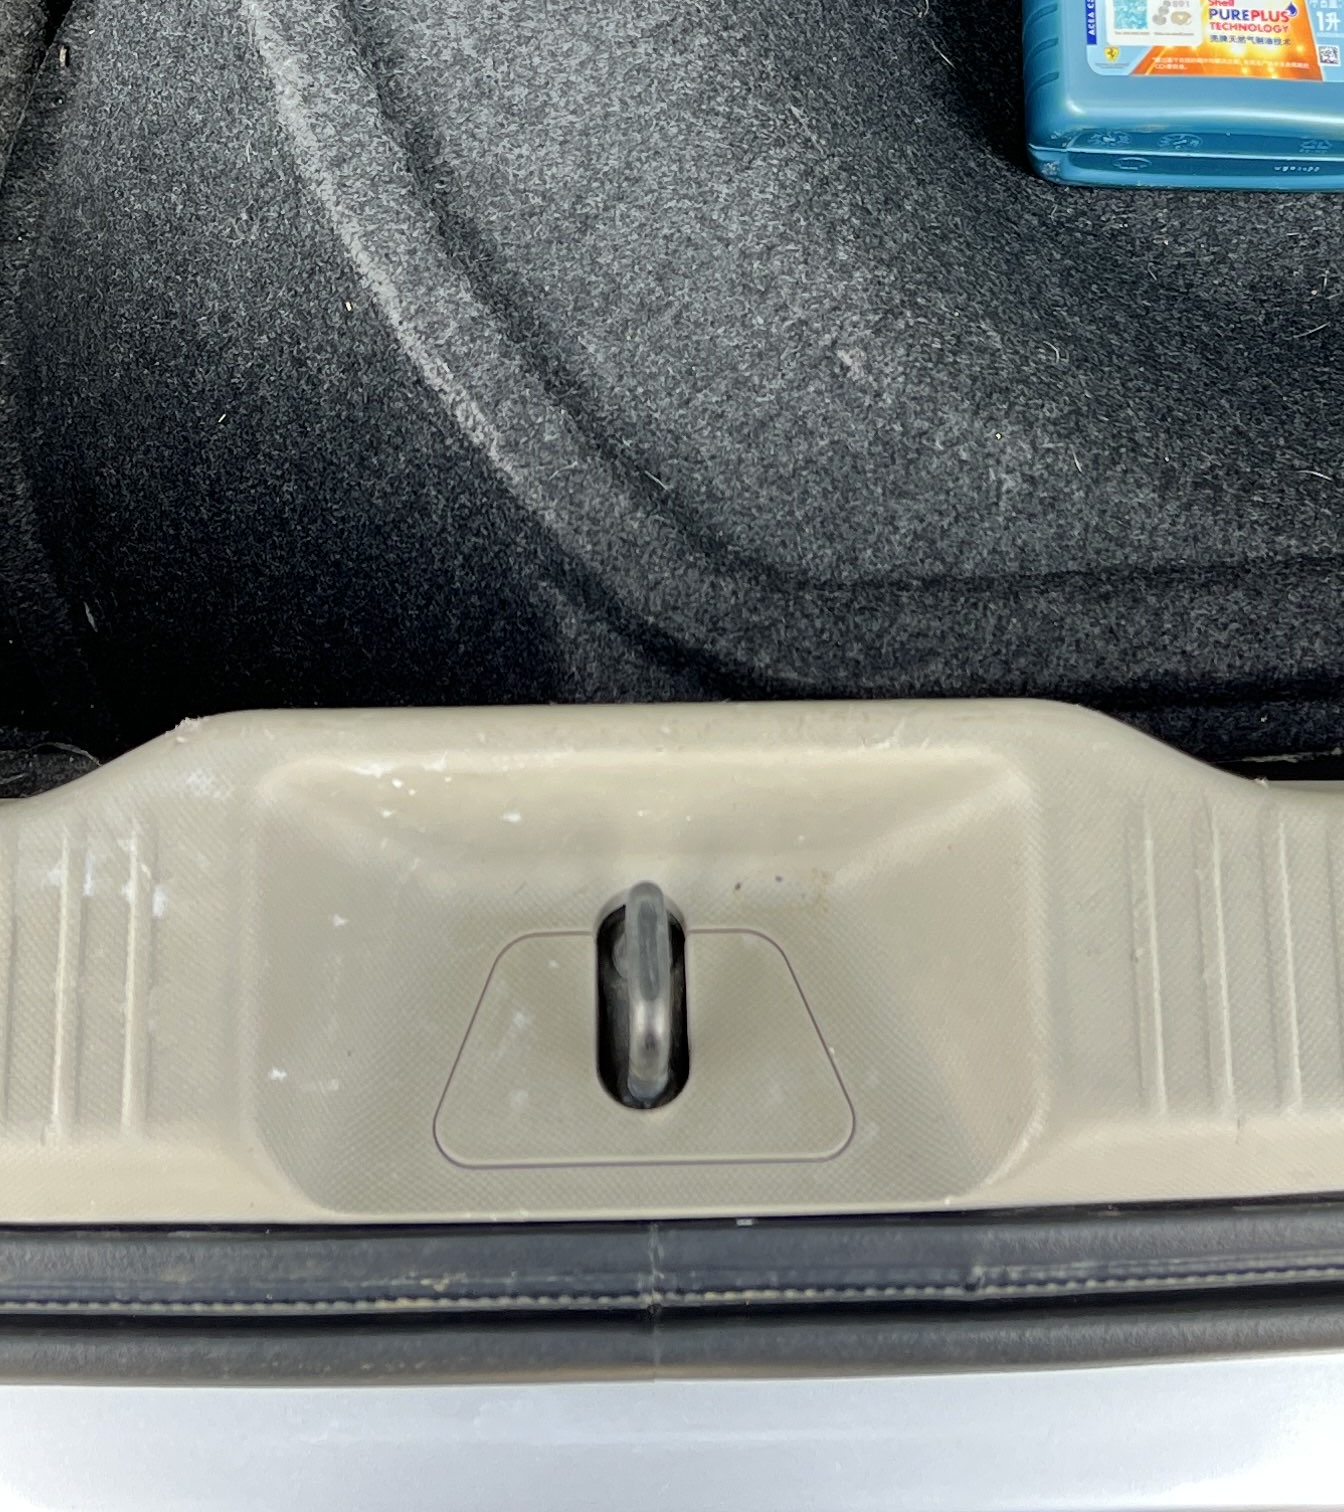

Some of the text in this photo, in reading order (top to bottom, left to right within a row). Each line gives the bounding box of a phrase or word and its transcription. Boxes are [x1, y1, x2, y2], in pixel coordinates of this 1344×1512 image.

[1209, 8, 1289, 23] PUREPLUS
[1316, 11, 1341, 31] 1升
[1209, 22, 1289, 33] TECHNOLOGY
